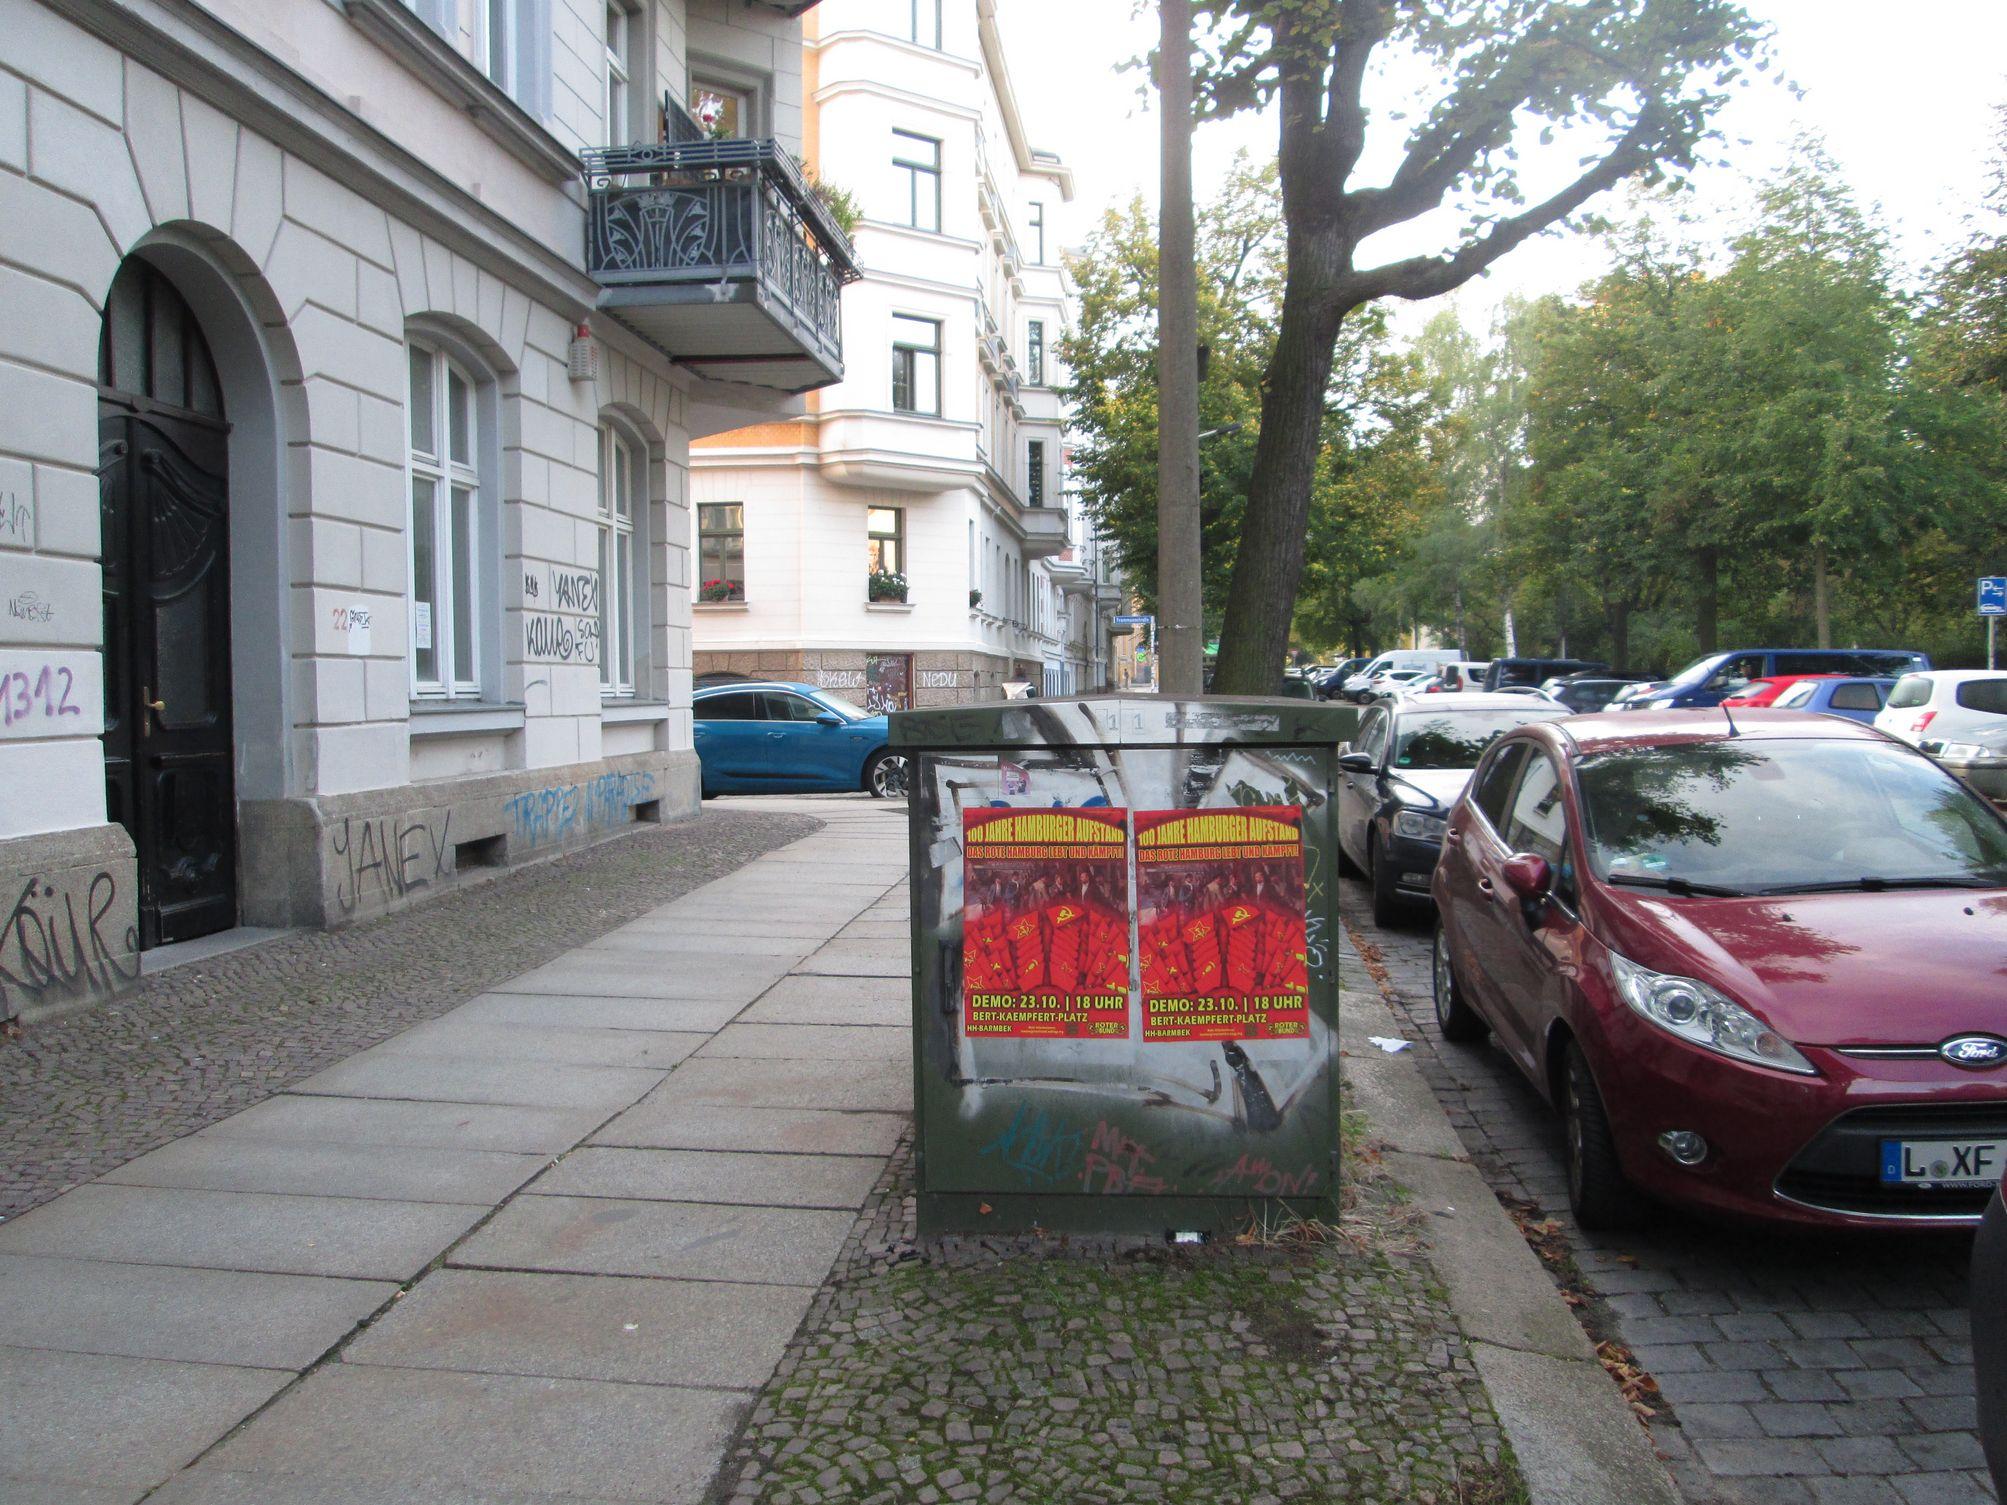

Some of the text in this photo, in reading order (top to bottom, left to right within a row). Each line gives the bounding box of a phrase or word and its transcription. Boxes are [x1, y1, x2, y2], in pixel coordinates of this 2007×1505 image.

[1981, 580, 1993, 595] P
[333, 608, 348, 630] 22
[966, 814, 1125, 842] 100 JAHRE HAMBURGER AUFSTAND
[1138, 815, 1298, 846] 100 JAHRE HAMBURGER AUFSTAND
[967, 846, 983, 858] DAS
[985, 846, 1006, 858] ROTE
[1007, 846, 1047, 858] HAMBURG
[1049, 846, 1068, 858] LEBT
[1069, 846, 1087, 858] UND
[1139, 850, 1156, 862] DAS
[1157, 849, 1178, 861] ROTE
[1180, 848, 1220, 860] HAMBURG
[1222, 847, 1242, 859] LEBT
[1243, 846, 1260, 858] UND
[972, 995, 1016, 1008] DEMO:
[1020, 995, 1060, 1008] 23.10.
[1076, 996, 1090, 1008] 18
[1095, 997, 1123, 1009] UHR
[1150, 999, 1193, 1012] DEMO:
[1198, 998, 1238, 1011] 23.10.
[1254, 997, 1269, 1009] 18
[1274, 996, 1302, 1009] UHR
[973, 1012, 1087, 1022] BERT-KAEMPFERT-PLATZ
[1151, 1014, 1267, 1025] BERT-KAEMPFERT-PLATZ
[1958, 1042, 1998, 1059] Ford
[1904, 1145, 1996, 1177] L XF
